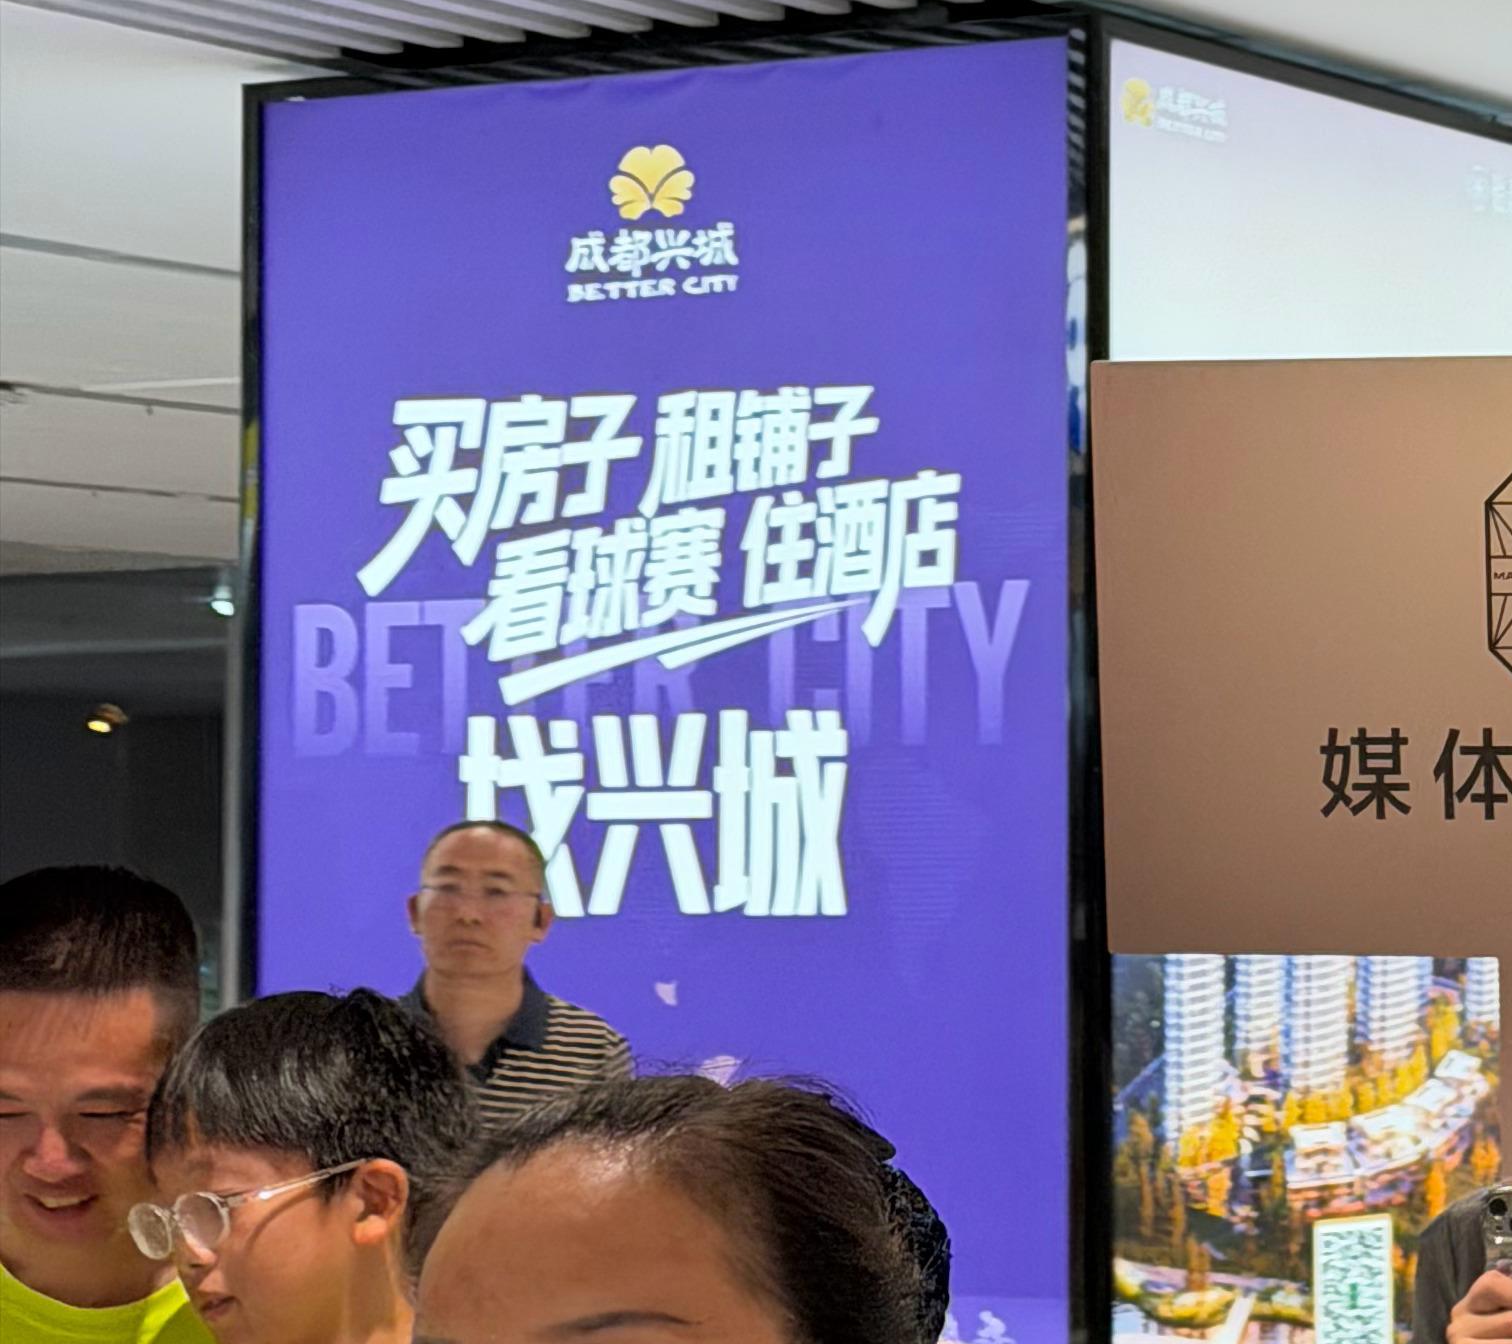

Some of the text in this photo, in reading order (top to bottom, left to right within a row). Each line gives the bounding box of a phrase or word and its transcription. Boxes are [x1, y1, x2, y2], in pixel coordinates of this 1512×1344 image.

[565, 222, 740, 277] 成都兴城
[567, 274, 740, 303] BETTER CITY
[356, 385, 880, 597] 买房子 租铺子
[460, 470, 962, 662] 看球赛 住酒店
[292, 595, 698, 757] BETR
[459, 709, 849, 917] 找兴城
